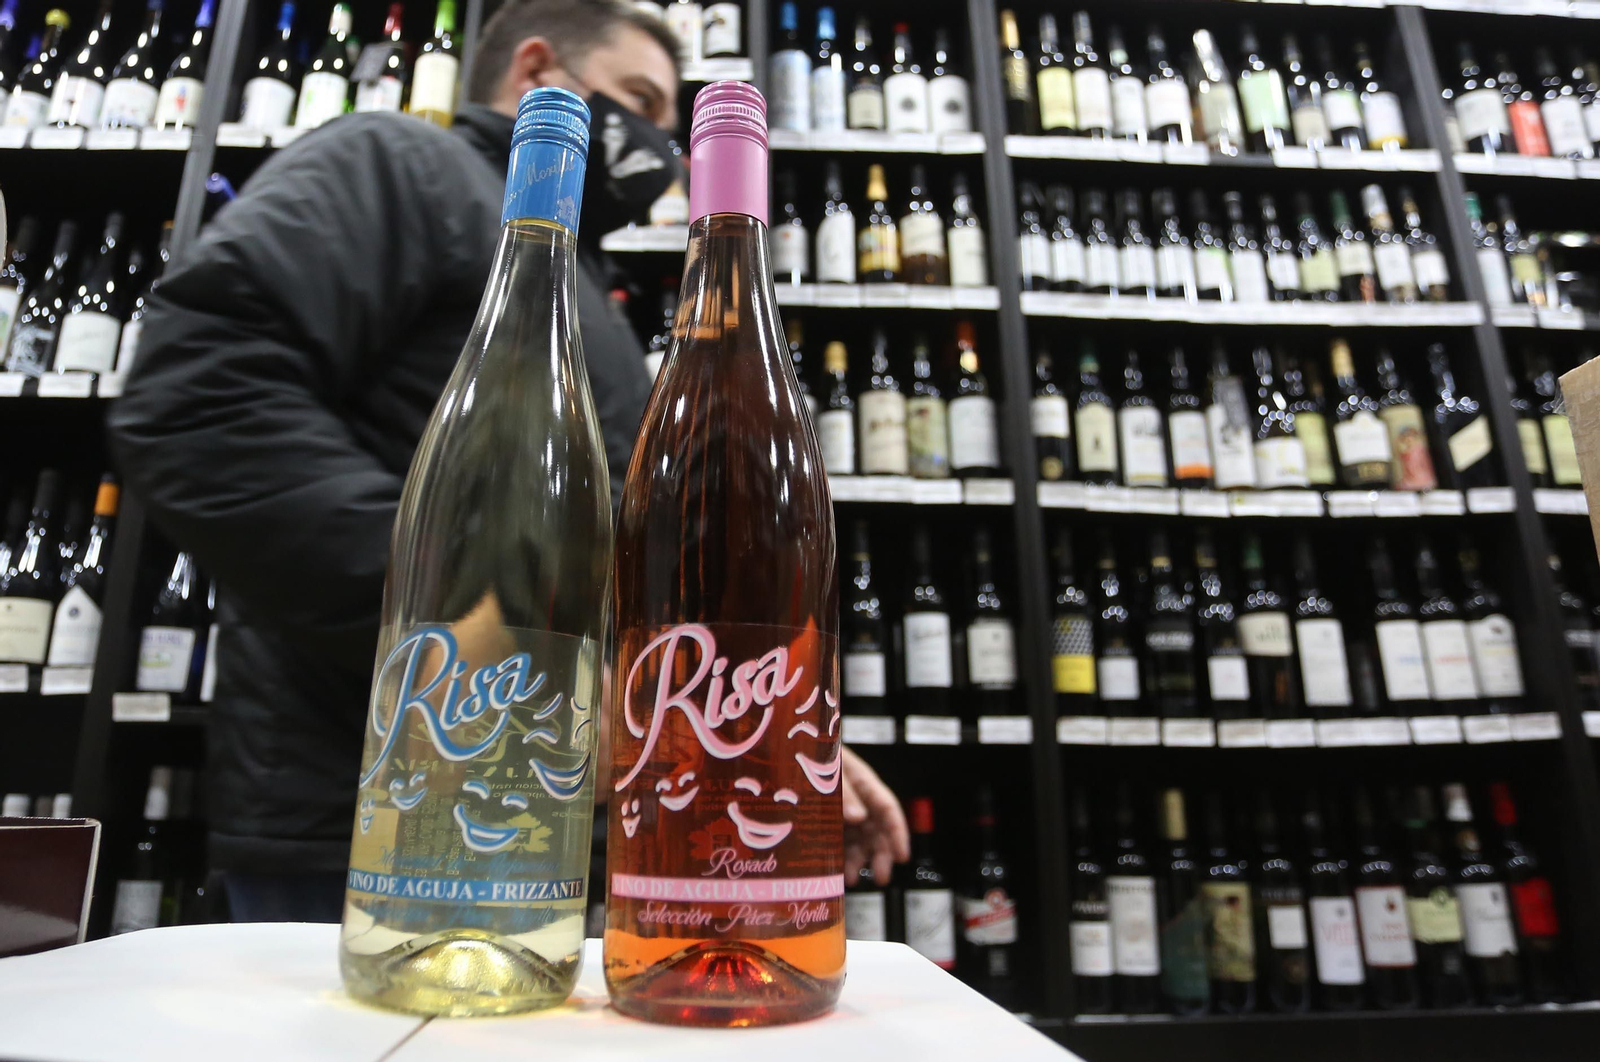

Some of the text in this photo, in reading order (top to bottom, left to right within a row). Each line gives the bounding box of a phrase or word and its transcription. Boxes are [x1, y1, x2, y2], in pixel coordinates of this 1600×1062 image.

[360, 627, 547, 788] Risa
[615, 623, 803, 792] Risa
[702, 848, 778, 879] Rosado
[375, 876, 398, 896] DE
[402, 879, 473, 900] AGUJA
[492, 880, 582, 901] FRIZZANTE
[650, 880, 676, 898] DE
[680, 881, 754, 901] AGUJA
[637, 901, 713, 926] Selección
